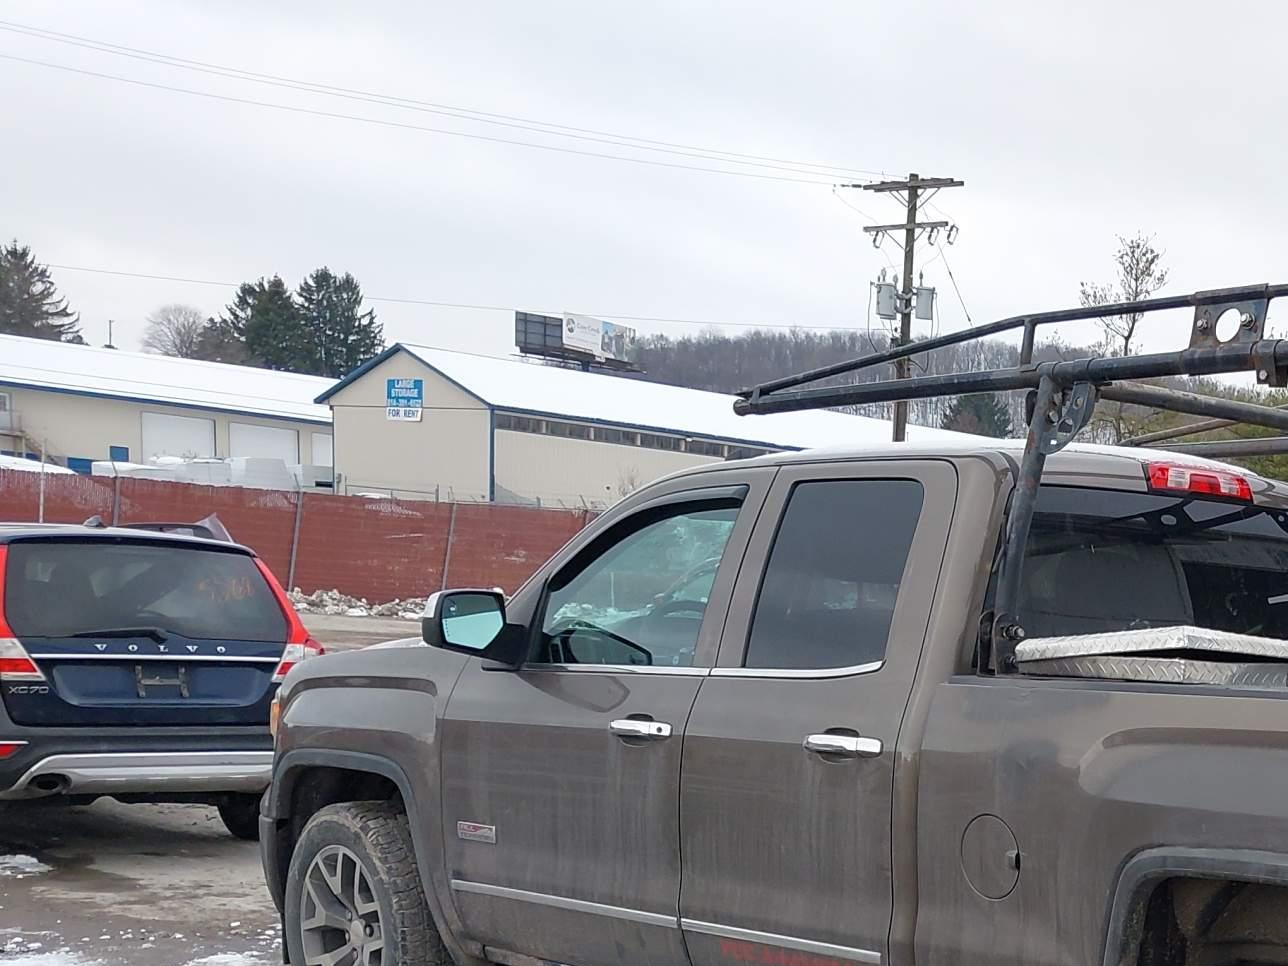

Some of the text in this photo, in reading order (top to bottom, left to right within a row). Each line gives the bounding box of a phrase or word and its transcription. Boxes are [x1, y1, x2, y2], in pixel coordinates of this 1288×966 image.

[387, 408, 420, 418] FOR RENT
[94, 644, 227, 654] VOLVO
[8, 685, 50, 695] XC70
